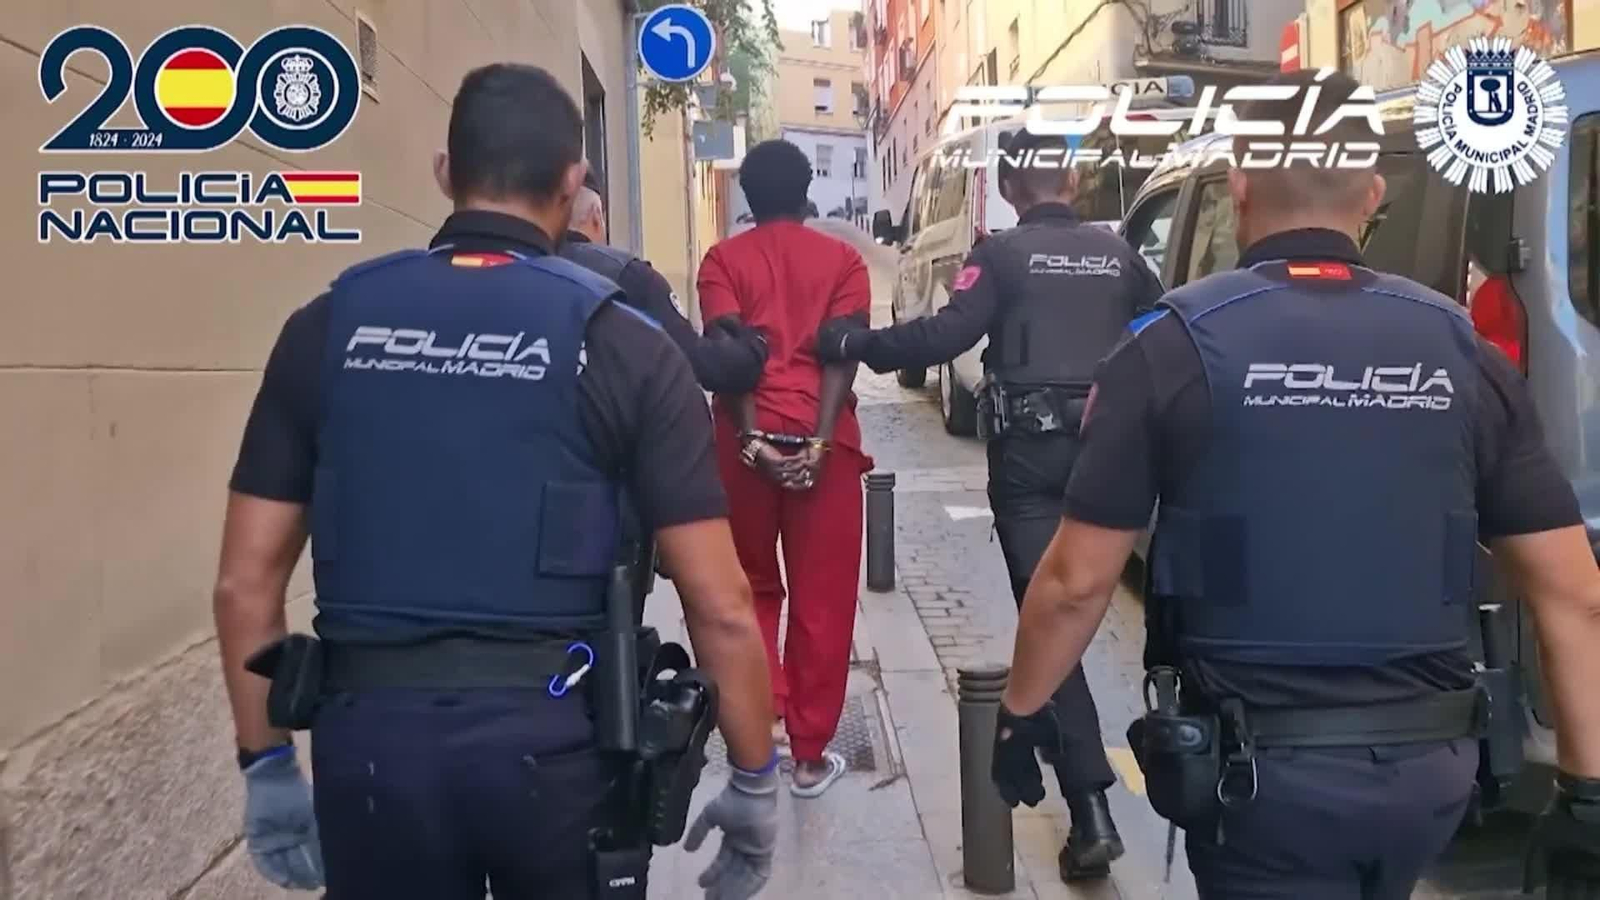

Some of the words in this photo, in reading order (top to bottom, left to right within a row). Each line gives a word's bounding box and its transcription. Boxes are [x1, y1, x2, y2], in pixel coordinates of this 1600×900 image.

[440, 359, 546, 381] MADRID
[1243, 395, 1346, 408] MUNICIPAL
[1347, 393, 1452, 411] MADRID
